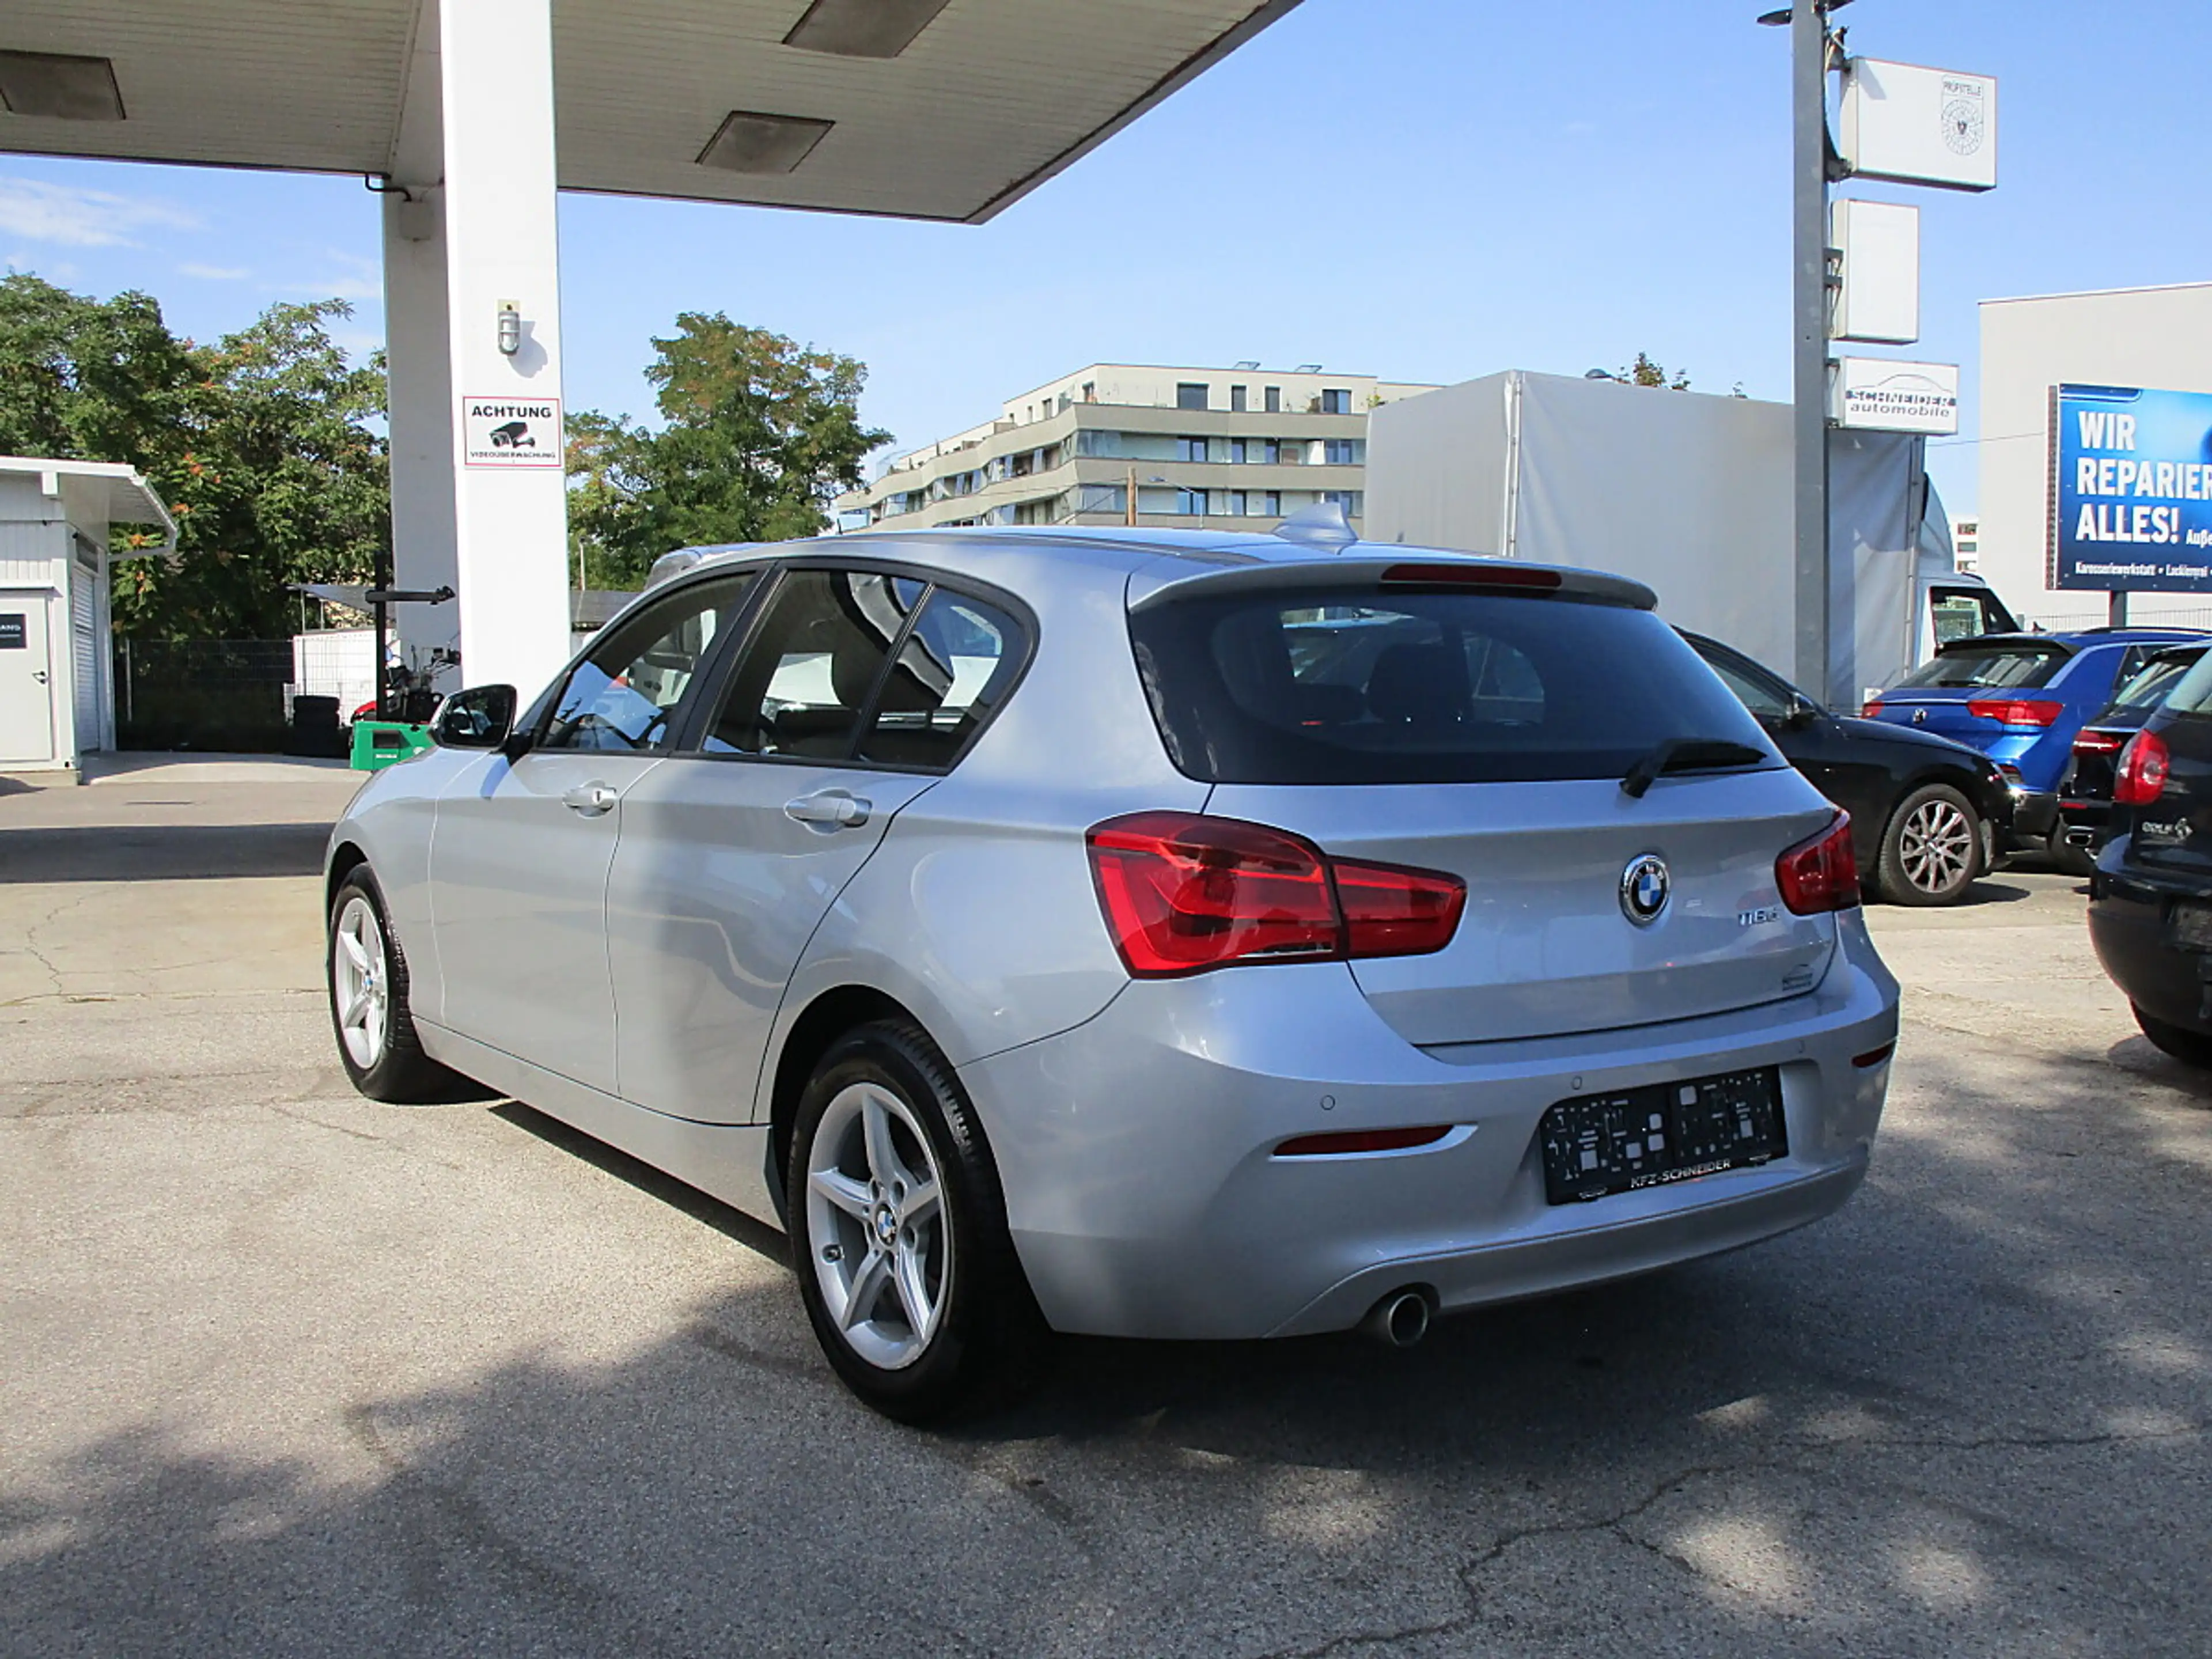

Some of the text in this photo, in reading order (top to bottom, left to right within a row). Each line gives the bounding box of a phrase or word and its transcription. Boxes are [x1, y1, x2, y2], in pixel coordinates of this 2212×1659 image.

[471, 405, 552, 418] ACHTUNG
[1850, 403, 1950, 418] automobile
[2078, 411, 2137, 451] WIR
[2076, 457, 2212, 500] REPARIER
[2075, 503, 2180, 544] ALLES!
